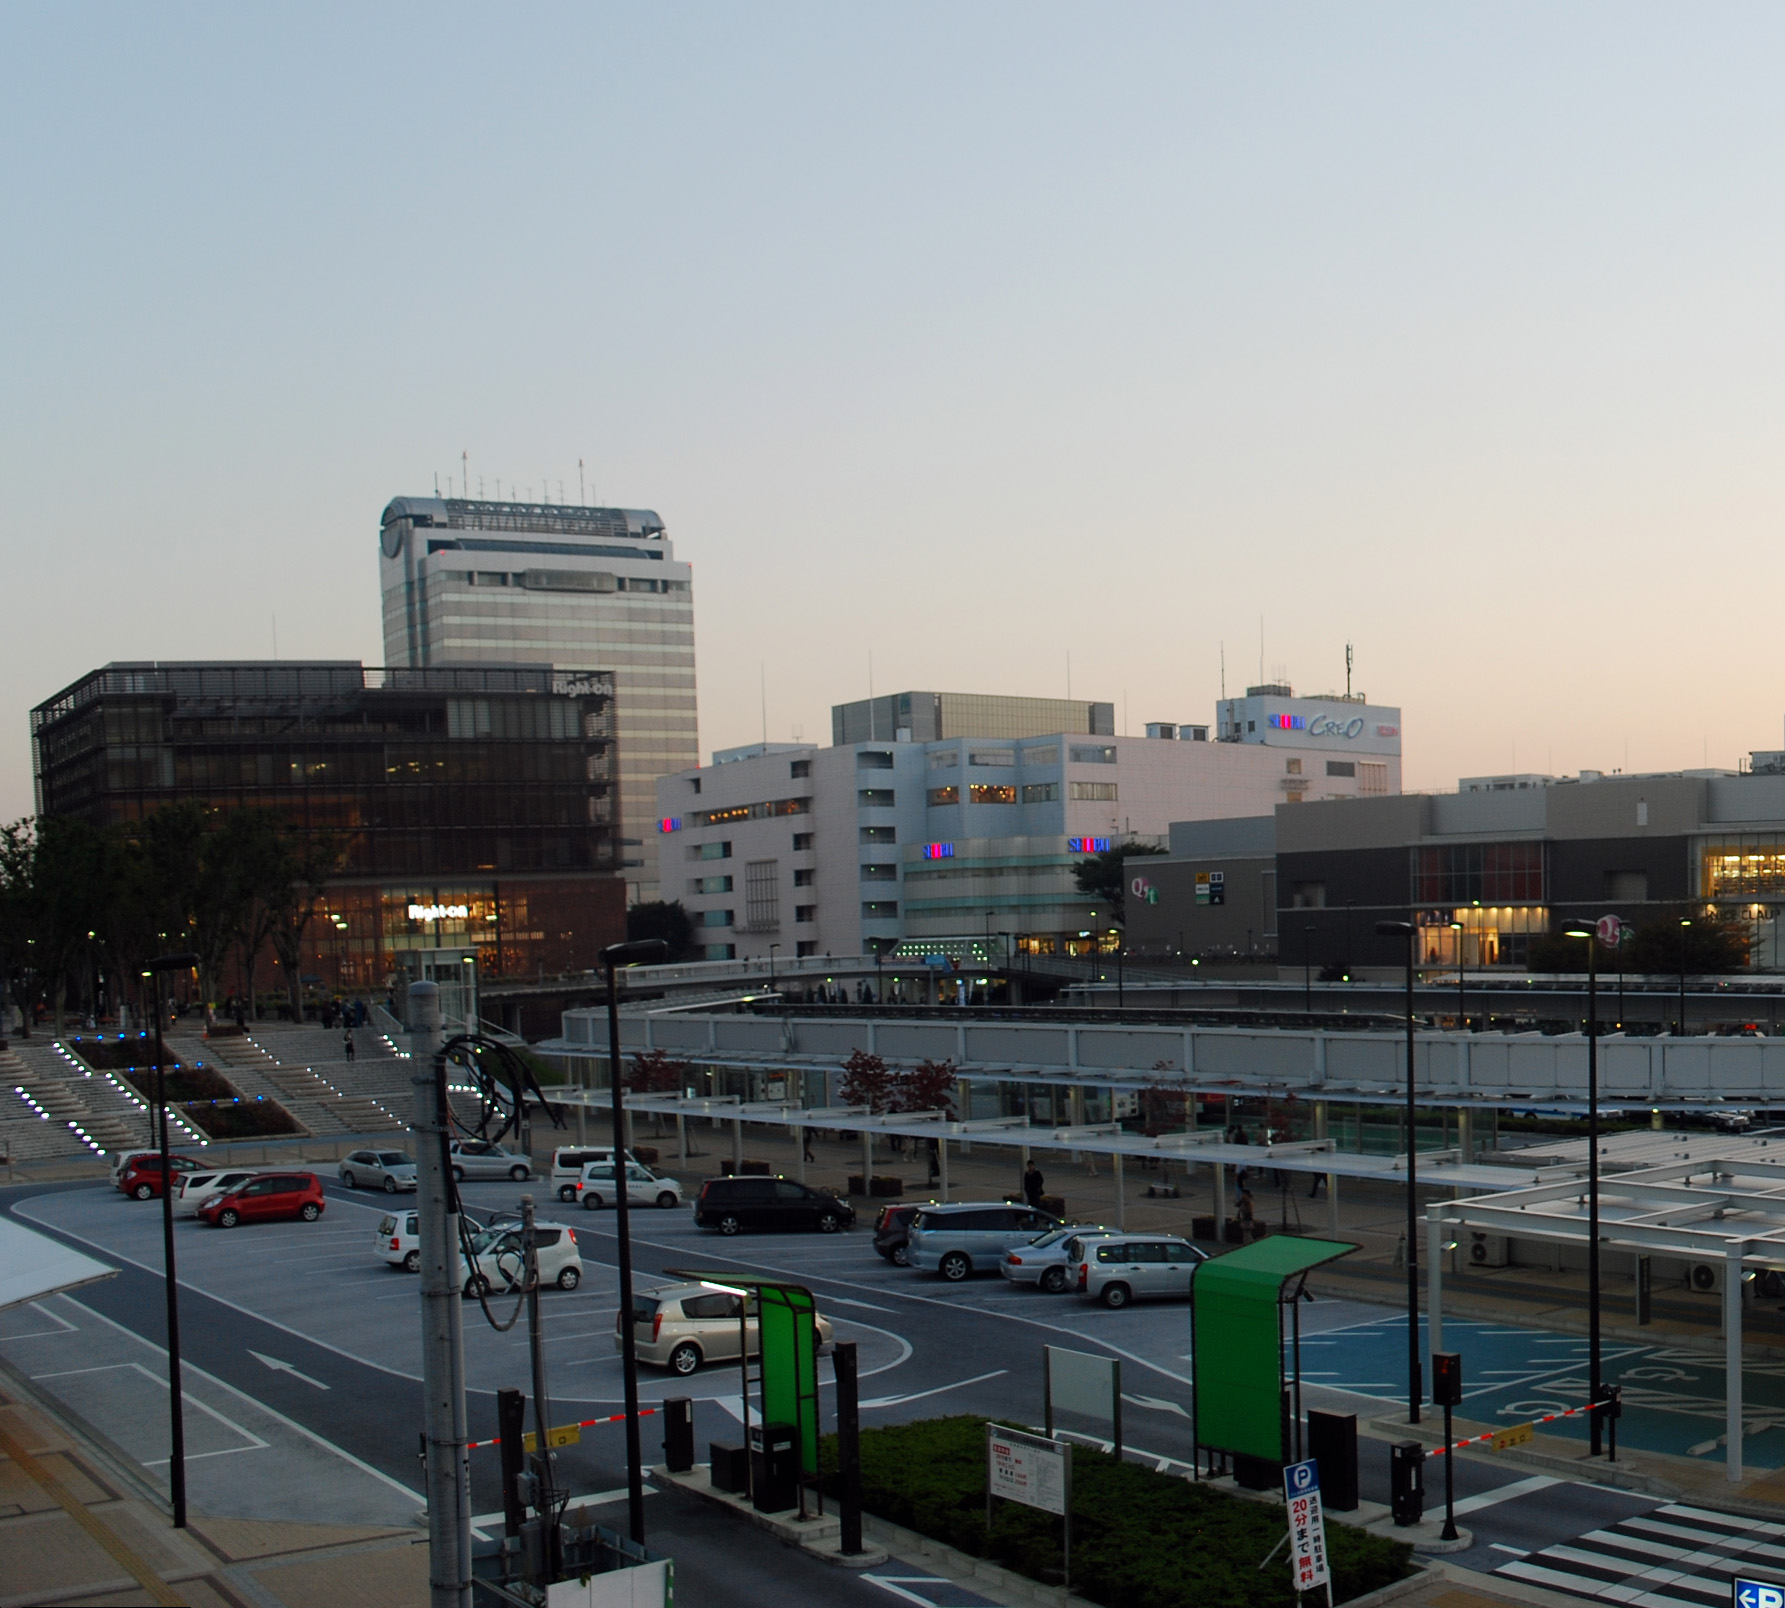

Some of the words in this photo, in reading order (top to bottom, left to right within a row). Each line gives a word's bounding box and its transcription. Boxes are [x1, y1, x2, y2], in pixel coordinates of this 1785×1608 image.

[1297, 1468, 1309, 1486] P
[1293, 1498, 1314, 1583] 20分まで無料
[1309, 1496, 1324, 1573] 送迎用一時駐車場
